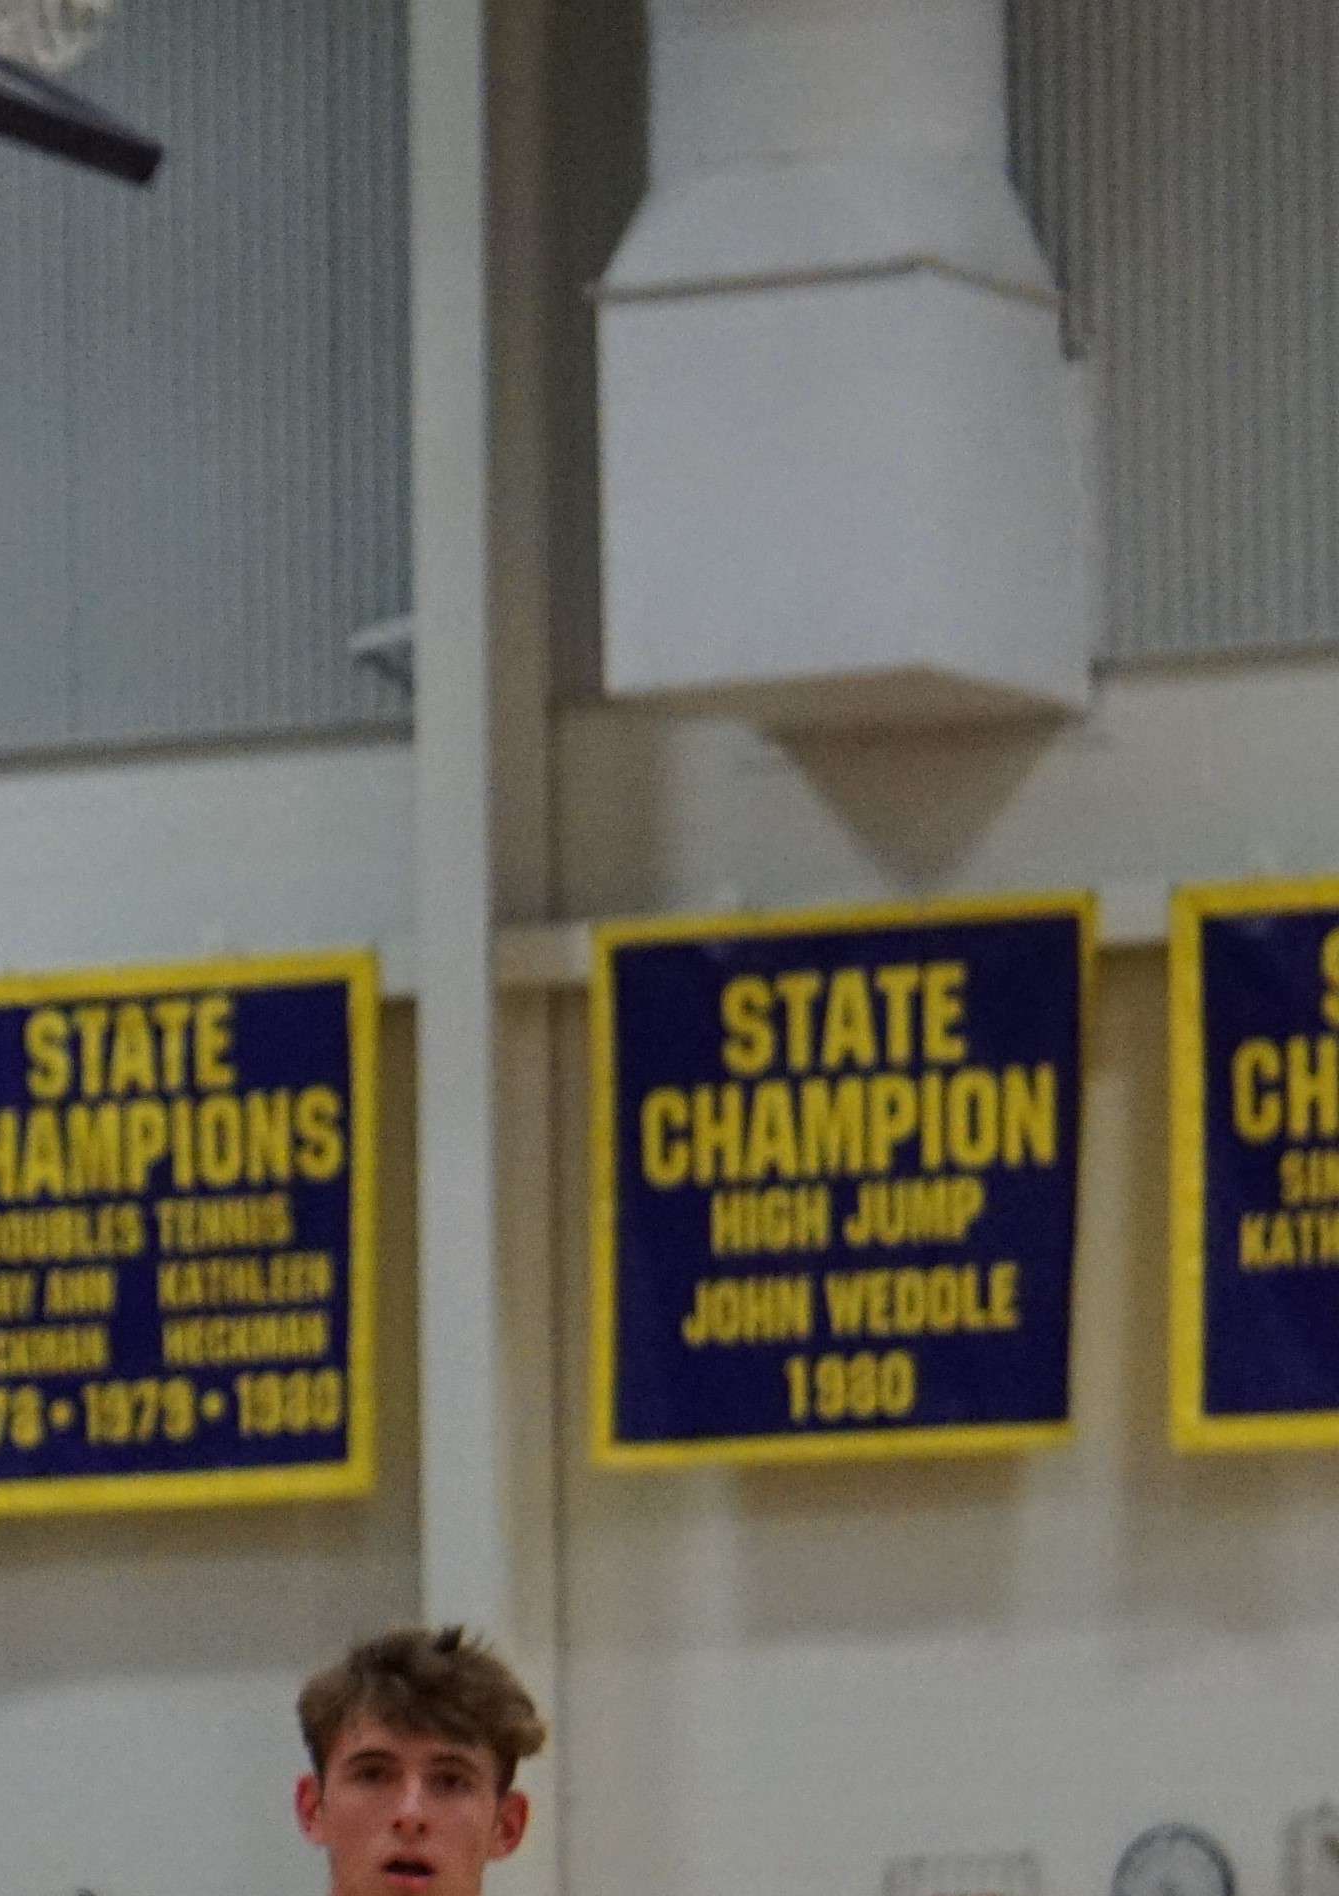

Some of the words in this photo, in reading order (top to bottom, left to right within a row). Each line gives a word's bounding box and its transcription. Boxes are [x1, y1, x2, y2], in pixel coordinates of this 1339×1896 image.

[25, 996, 235, 1099] STATE
[721, 962, 967, 1076] STATE
[640, 1064, 1057, 1188] CHAMPION
[157, 1192, 293, 1252] TENNIS
[710, 1185, 831, 1256] HIGH
[842, 1175, 986, 1248] JUMP
[43, 1264, 116, 1317] ANN
[157, 1251, 333, 1310] KATHLEEN
[681, 1275, 813, 1347] JOHN
[785, 1350, 917, 1423] 1980
